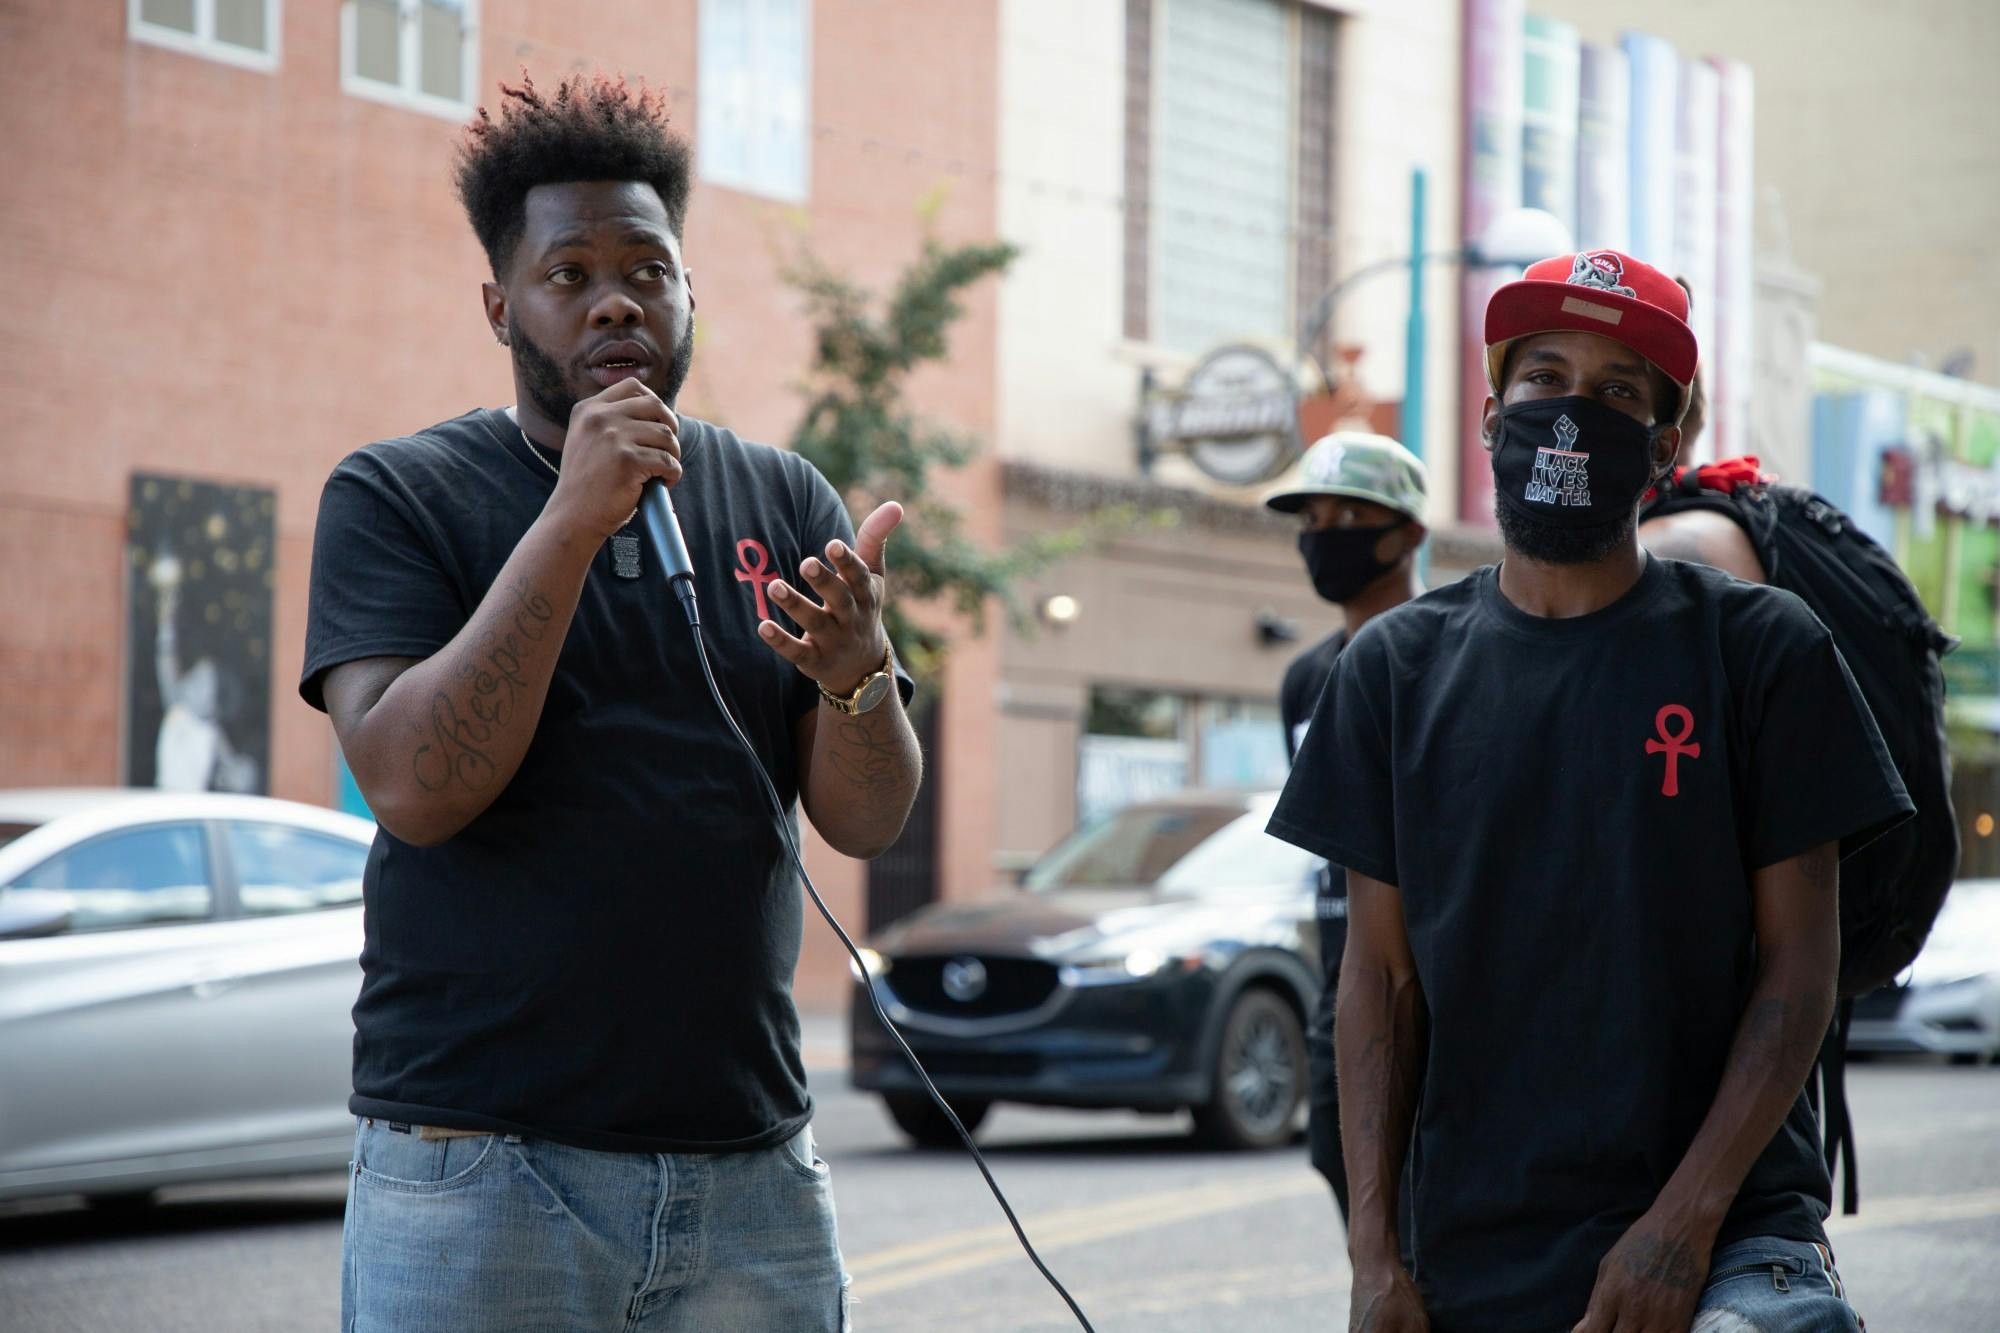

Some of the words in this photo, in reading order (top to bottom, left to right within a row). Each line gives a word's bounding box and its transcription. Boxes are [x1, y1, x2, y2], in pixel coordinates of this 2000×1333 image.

[1535, 451, 1589, 473] BLACK
[1532, 466, 1588, 489] LIVES
[1525, 482, 1591, 506] MATTER
[413, 576, 553, 791] Respect
